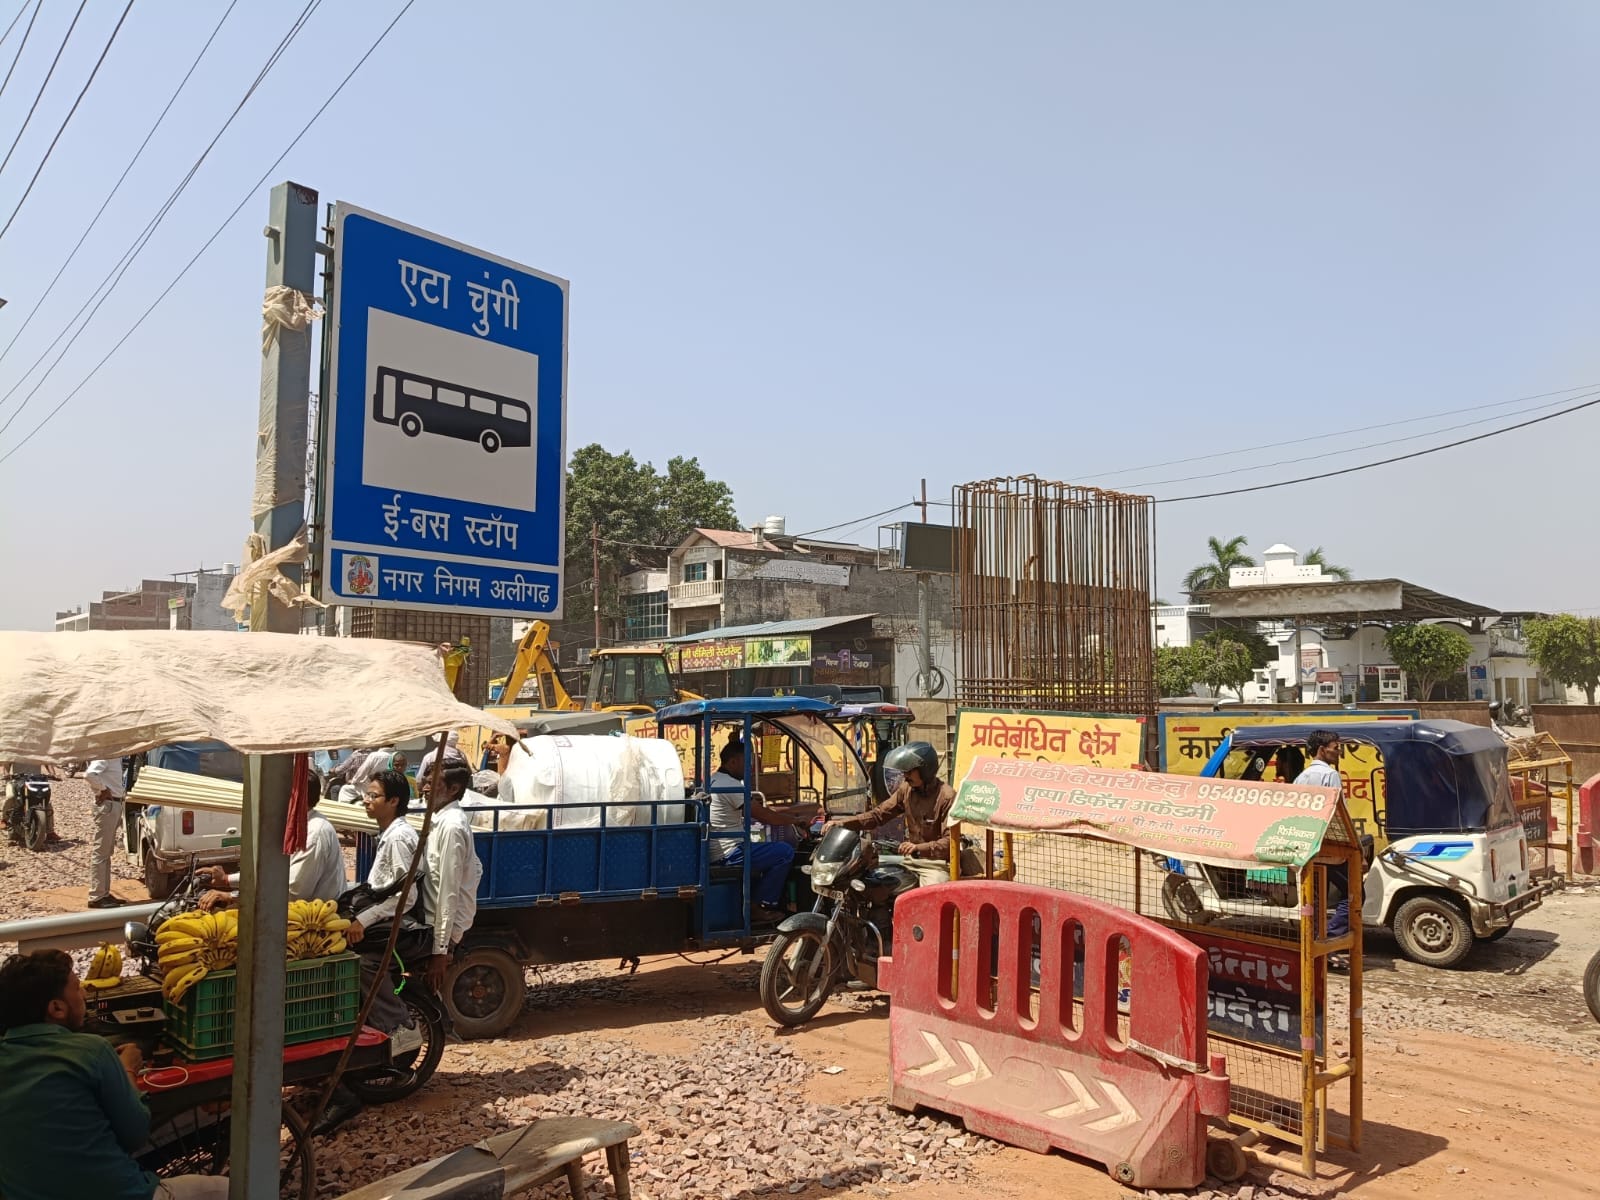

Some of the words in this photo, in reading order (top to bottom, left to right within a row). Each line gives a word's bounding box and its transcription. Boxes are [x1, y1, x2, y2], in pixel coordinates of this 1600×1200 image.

[398, 259, 451, 309] एटा
[466, 271, 520, 336] चुंगी
[382, 494, 450, 542] ई-बस
[463, 512, 518, 550] स्टॉप
[382, 568, 424, 593] नगर
[434, 565, 480, 598] निगम
[490, 574, 550, 608] अलीगढ़
[970, 716, 1071, 753] प्रतिबंधित
[1078, 723, 1121, 759] क्षेत्र
[1197, 782, 1327, 812] 9548969288
